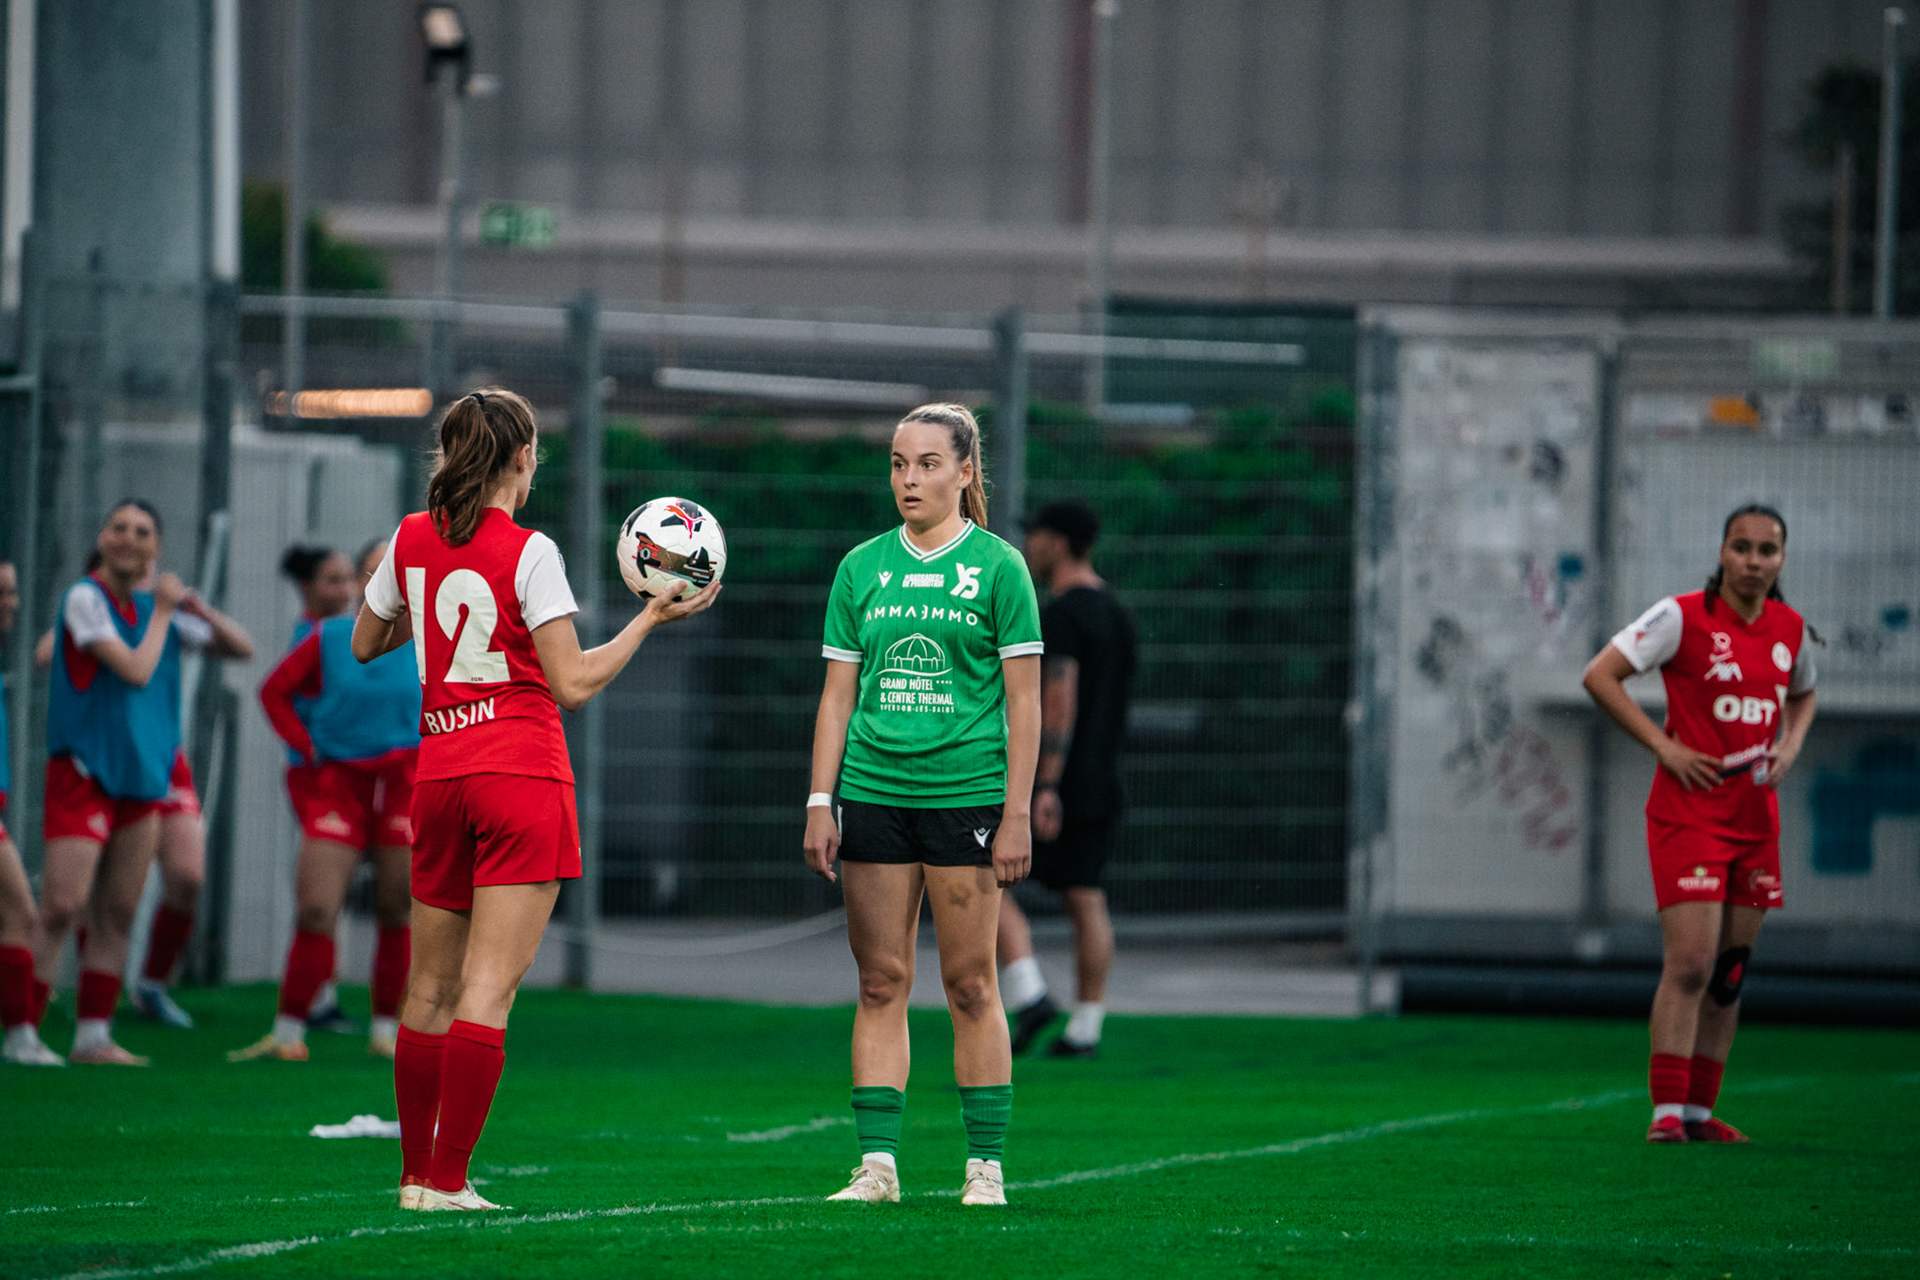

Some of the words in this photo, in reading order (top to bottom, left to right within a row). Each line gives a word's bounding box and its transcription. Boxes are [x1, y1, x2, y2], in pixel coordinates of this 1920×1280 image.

[405, 566, 511, 685] 12
[880, 677, 907, 690] GRAND
[909, 675, 934, 690] HÔTEL
[880, 692, 887, 703] &
[887, 691, 916, 704] CENTRE
[917, 692, 954, 705] THERMAL
[424, 697, 495, 734] BUSIN
